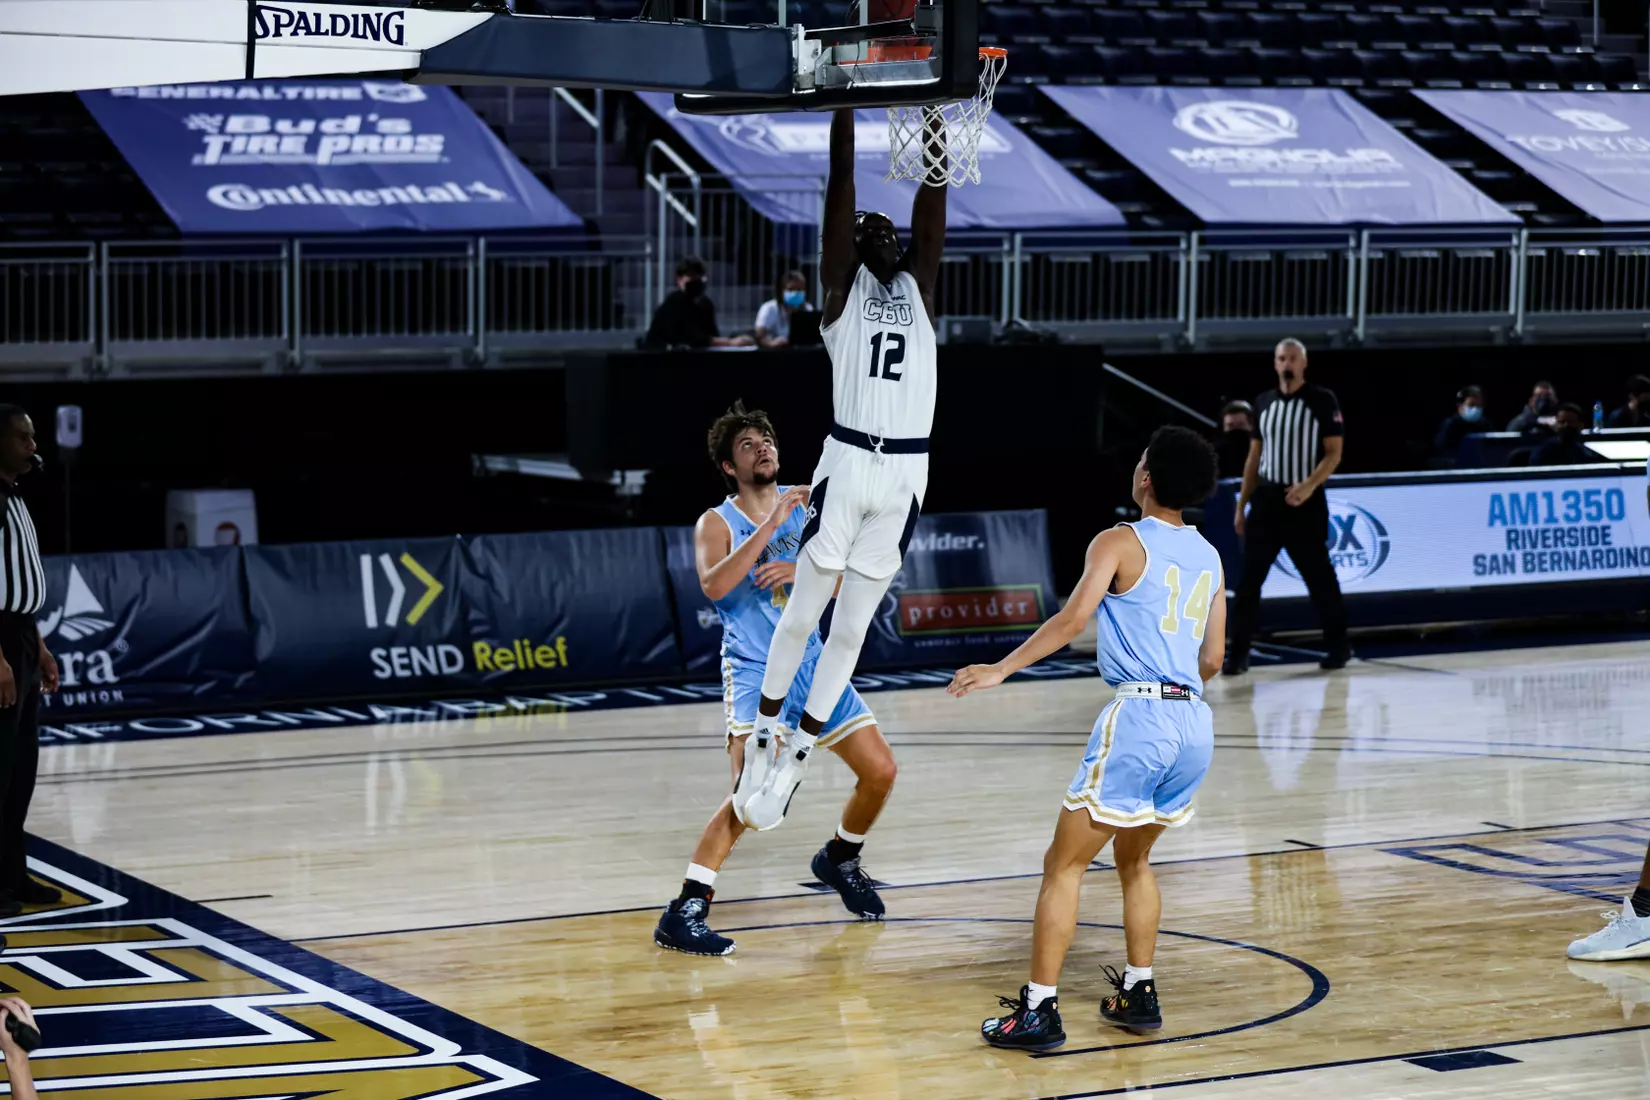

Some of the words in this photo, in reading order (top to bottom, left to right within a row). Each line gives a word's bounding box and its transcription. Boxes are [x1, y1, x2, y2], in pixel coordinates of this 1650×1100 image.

[255, 6, 404, 46] SPALDING
[224, 115, 413, 134] Bud's
[201, 135, 306, 164] TIRE
[206, 182, 469, 210] Continental
[863, 297, 913, 326] CBU
[869, 331, 905, 382] 12
[1488, 487, 1625, 527] AM1350
[1506, 525, 1613, 550] RIVERSIDE
[1331, 552, 1369, 568] RTS
[1473, 553, 1516, 576] SAN
[1522, 546, 1650, 574] BERNARDINO
[907, 596, 1029, 626] provider
[1160, 564, 1212, 640] 14
[370, 644, 464, 679] SEND
[471, 636, 568, 671] Relief
[62, 690, 124, 706] UNION
